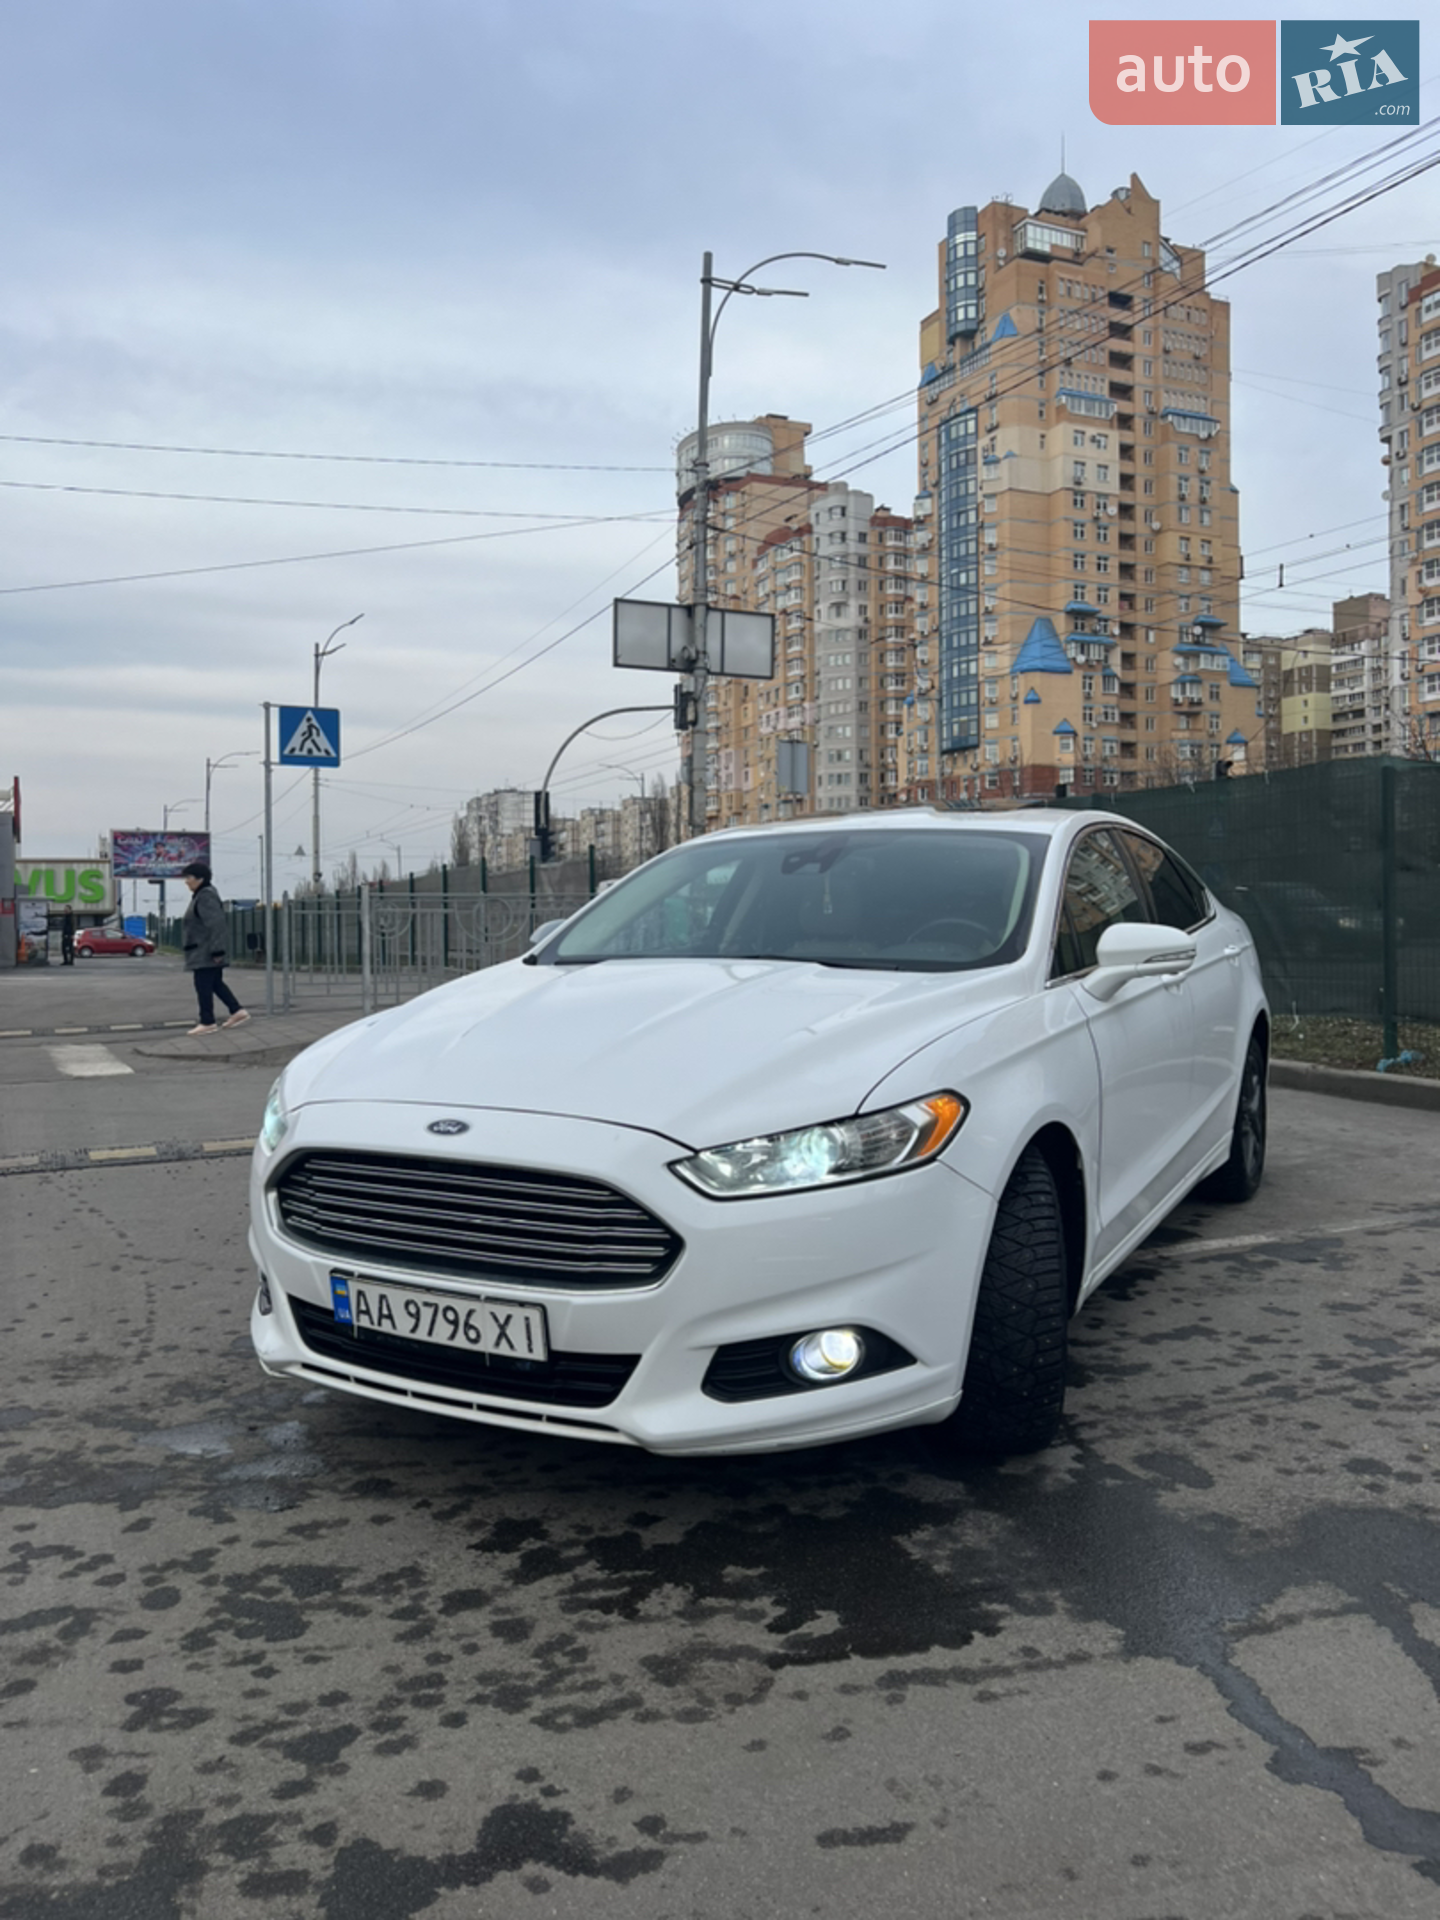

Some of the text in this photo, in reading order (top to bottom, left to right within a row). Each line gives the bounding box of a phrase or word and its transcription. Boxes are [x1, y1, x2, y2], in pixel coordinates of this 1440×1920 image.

[355, 1288, 534, 1354] AA 9796 XI
